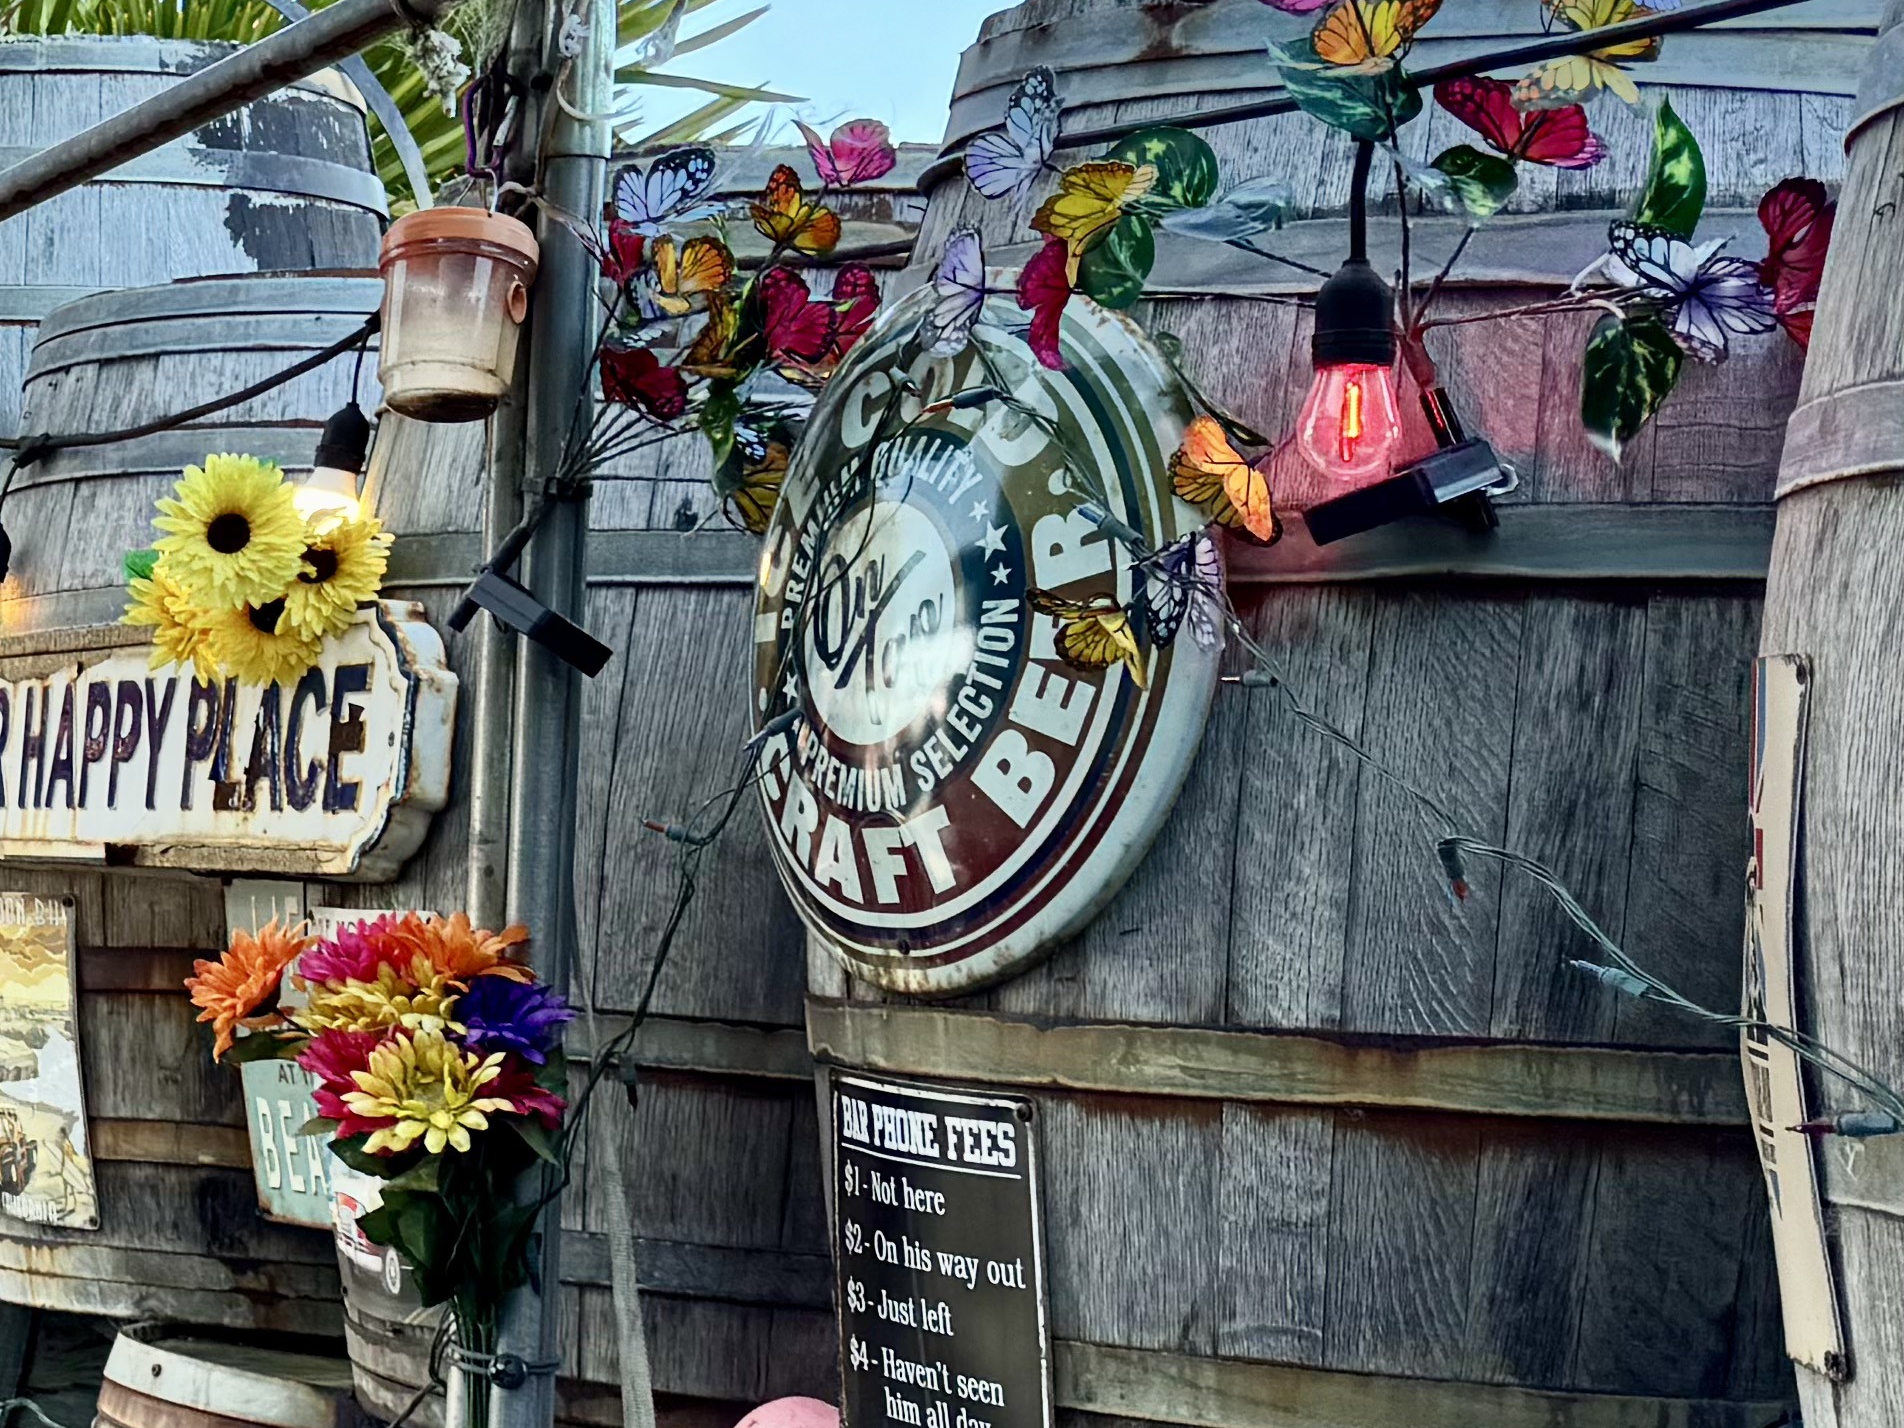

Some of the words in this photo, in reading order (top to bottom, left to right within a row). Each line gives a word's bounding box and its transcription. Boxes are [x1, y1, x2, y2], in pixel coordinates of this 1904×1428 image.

[873, 434, 983, 505] QUALITY
[813, 553, 885, 671] On
[18, 677, 177, 811] HAPPY
[180, 662, 376, 813] PLACE
[756, 731, 958, 905] CRAFT
[970, 512, 1114, 829] BEER
[800, 723, 907, 813] PREMIUM
[911, 598, 1020, 792] SELECTION
[278, 1062, 297, 1085] AT
[256, 1097, 329, 1196] BEA
[842, 1094, 870, 1144] BAR
[871, 1103, 940, 1158] PHONE
[944, 1116, 1016, 1168] FEES
[871, 1170, 898, 1206] Not
[902, 1177, 945, 1215] here
[874, 1230, 898, 1265] On
[902, 1236, 932, 1272] his
[936, 1252, 979, 1290] way
[986, 1257, 1026, 1290] out
[878, 1289, 918, 1329] Just
[921, 1298, 954, 1337] left
[881, 1346, 952, 1395] Haven't
[957, 1374, 1005, 1407] seen
[884, 1386, 922, 1427] him
